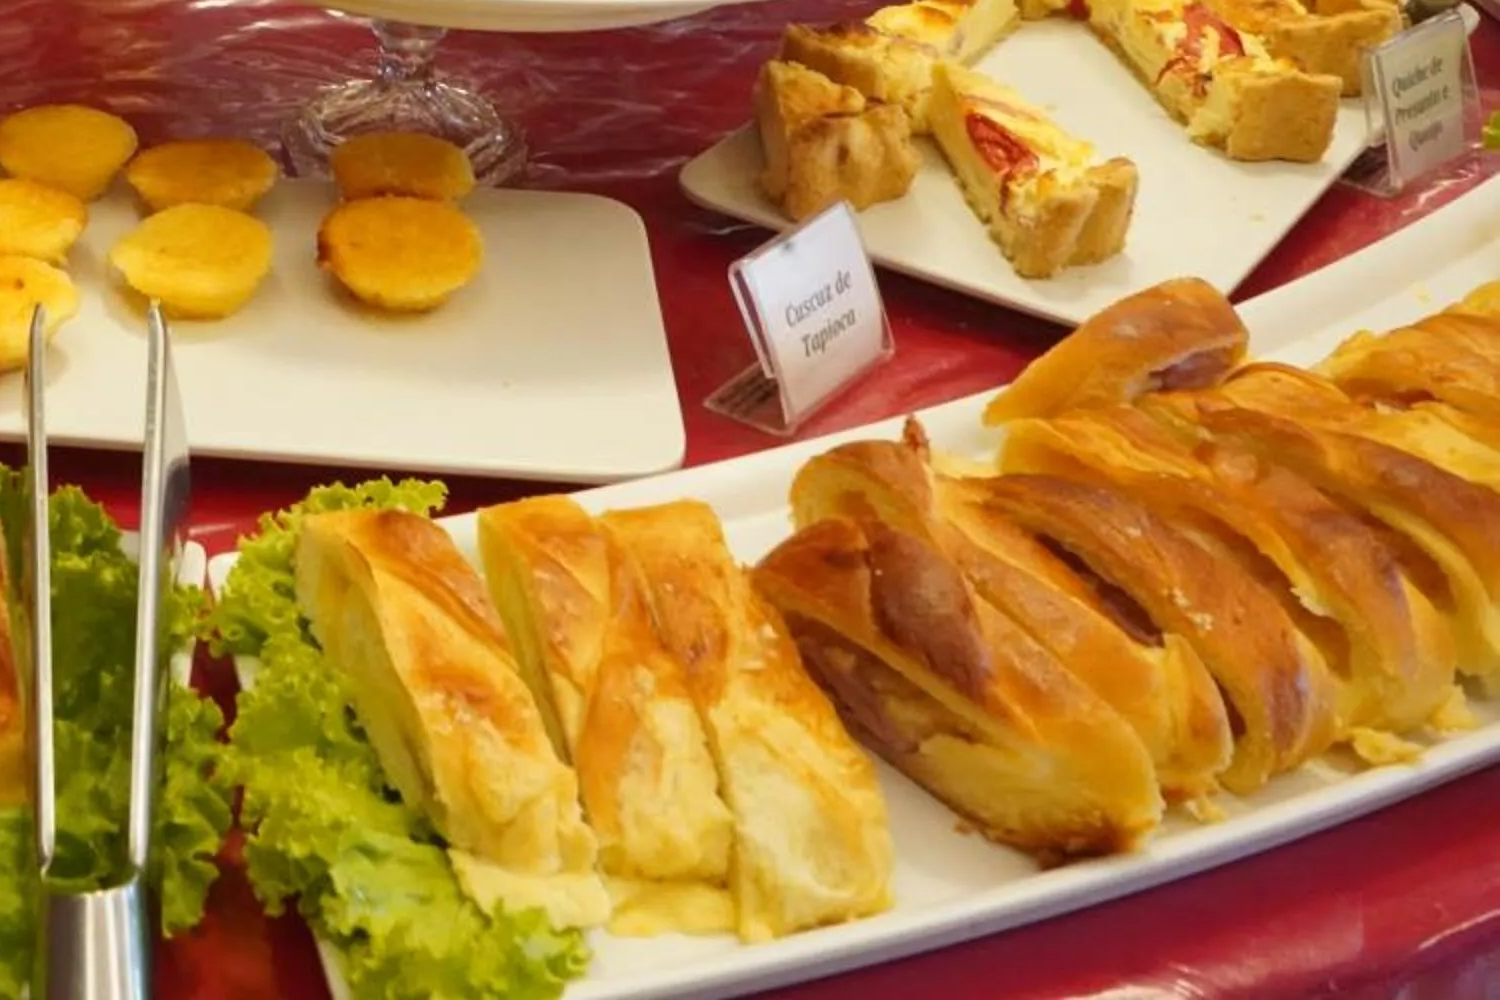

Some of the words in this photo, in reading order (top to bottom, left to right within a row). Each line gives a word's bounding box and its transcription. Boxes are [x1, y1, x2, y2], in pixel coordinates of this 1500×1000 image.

[785, 282, 833, 328] Cuscuz
[835, 269, 851, 294] de
[801, 308, 856, 357] Tapioca
